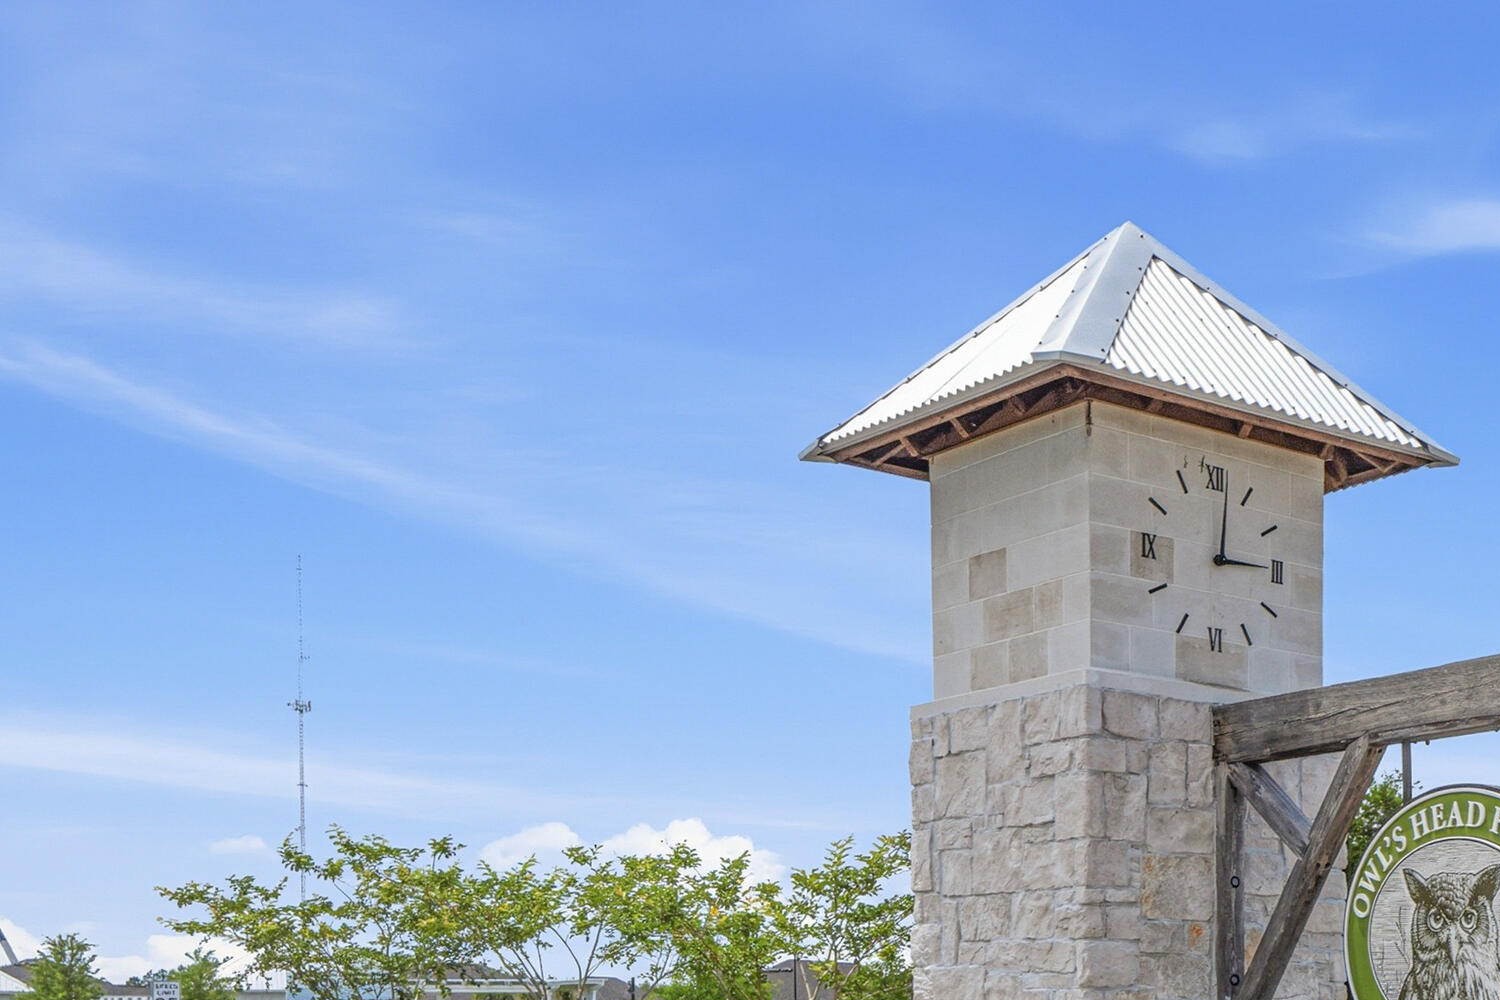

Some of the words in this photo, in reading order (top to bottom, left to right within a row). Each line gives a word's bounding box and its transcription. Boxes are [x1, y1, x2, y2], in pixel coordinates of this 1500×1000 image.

[1205, 463, 1225, 493] XII
[1141, 532, 1157, 560] IX
[1270, 559, 1284, 585] III
[1207, 626, 1222, 653] VI
[1352, 826, 1408, 919] OWL'S
[1408, 800, 1487, 840] HEAD
